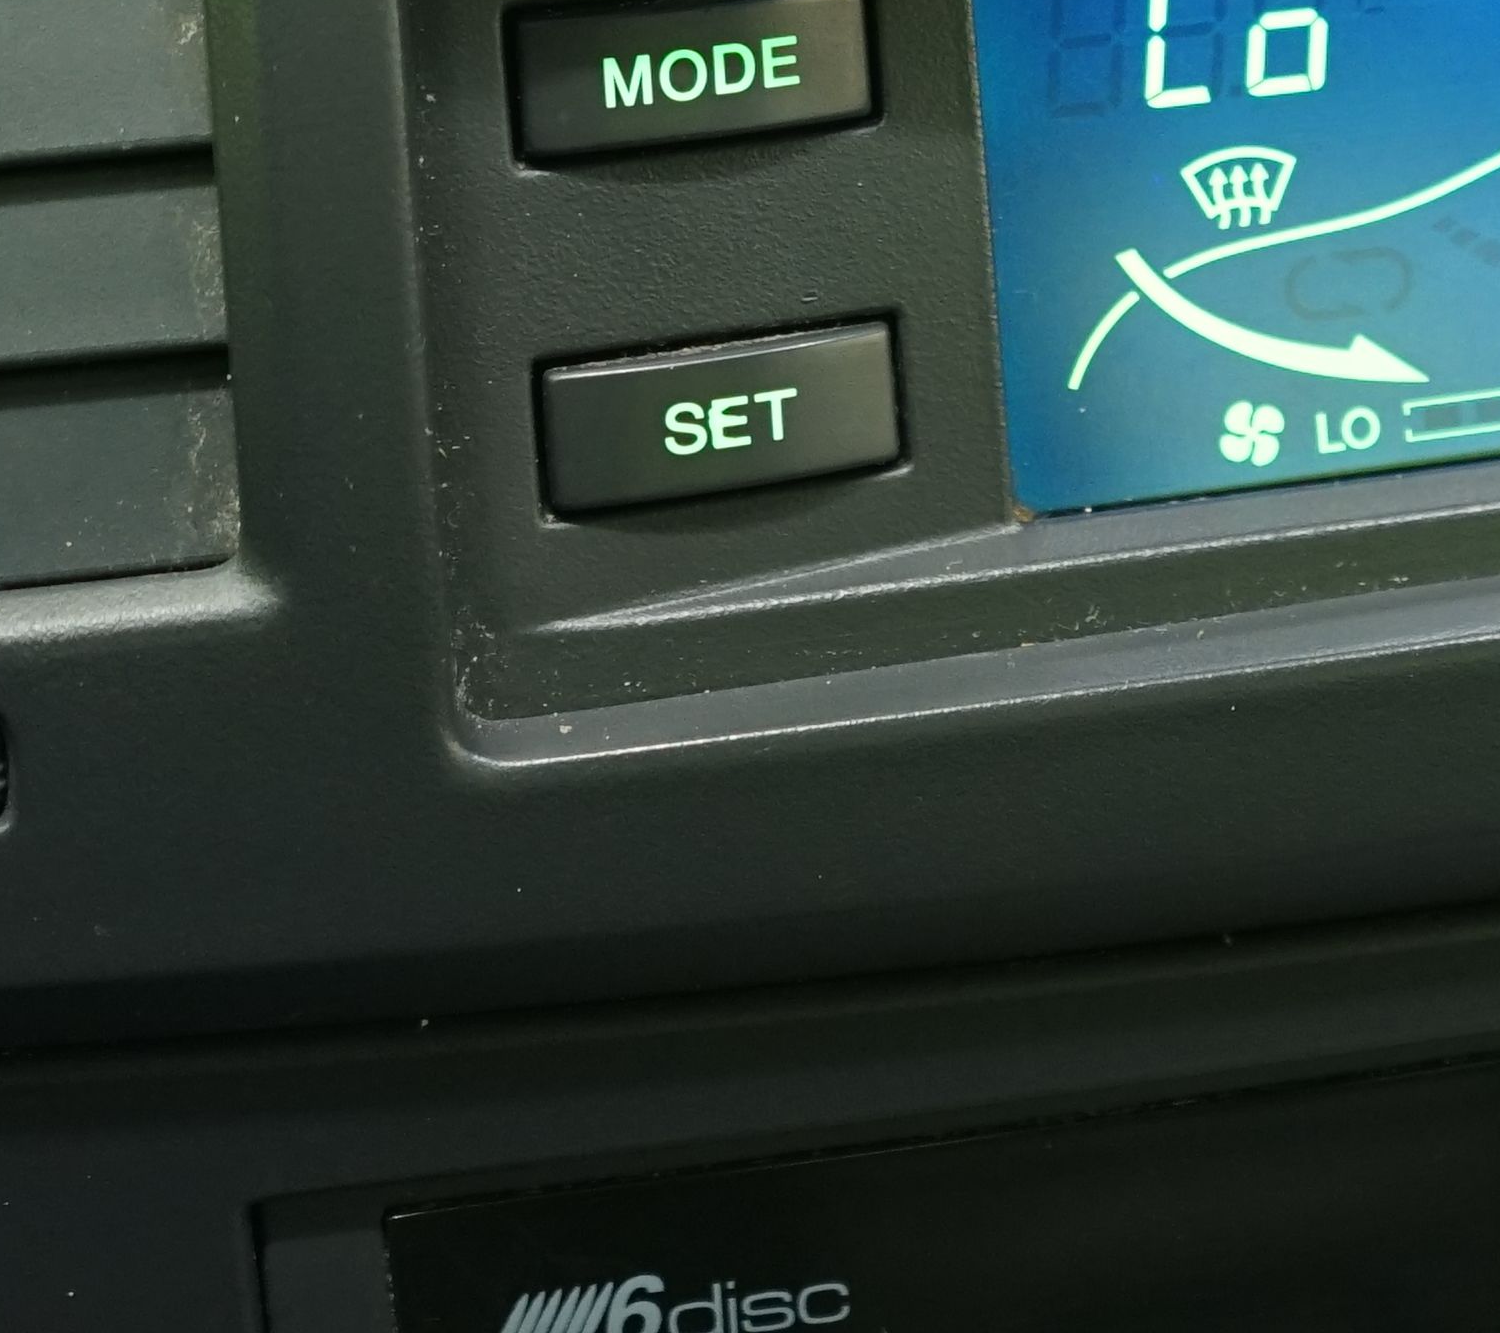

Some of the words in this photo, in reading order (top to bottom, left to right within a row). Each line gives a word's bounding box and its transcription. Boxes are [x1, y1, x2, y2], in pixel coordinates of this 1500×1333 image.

[602, 34, 802, 110] MODE
[664, 387, 799, 456] SET
[1313, 405, 1382, 455] LO
